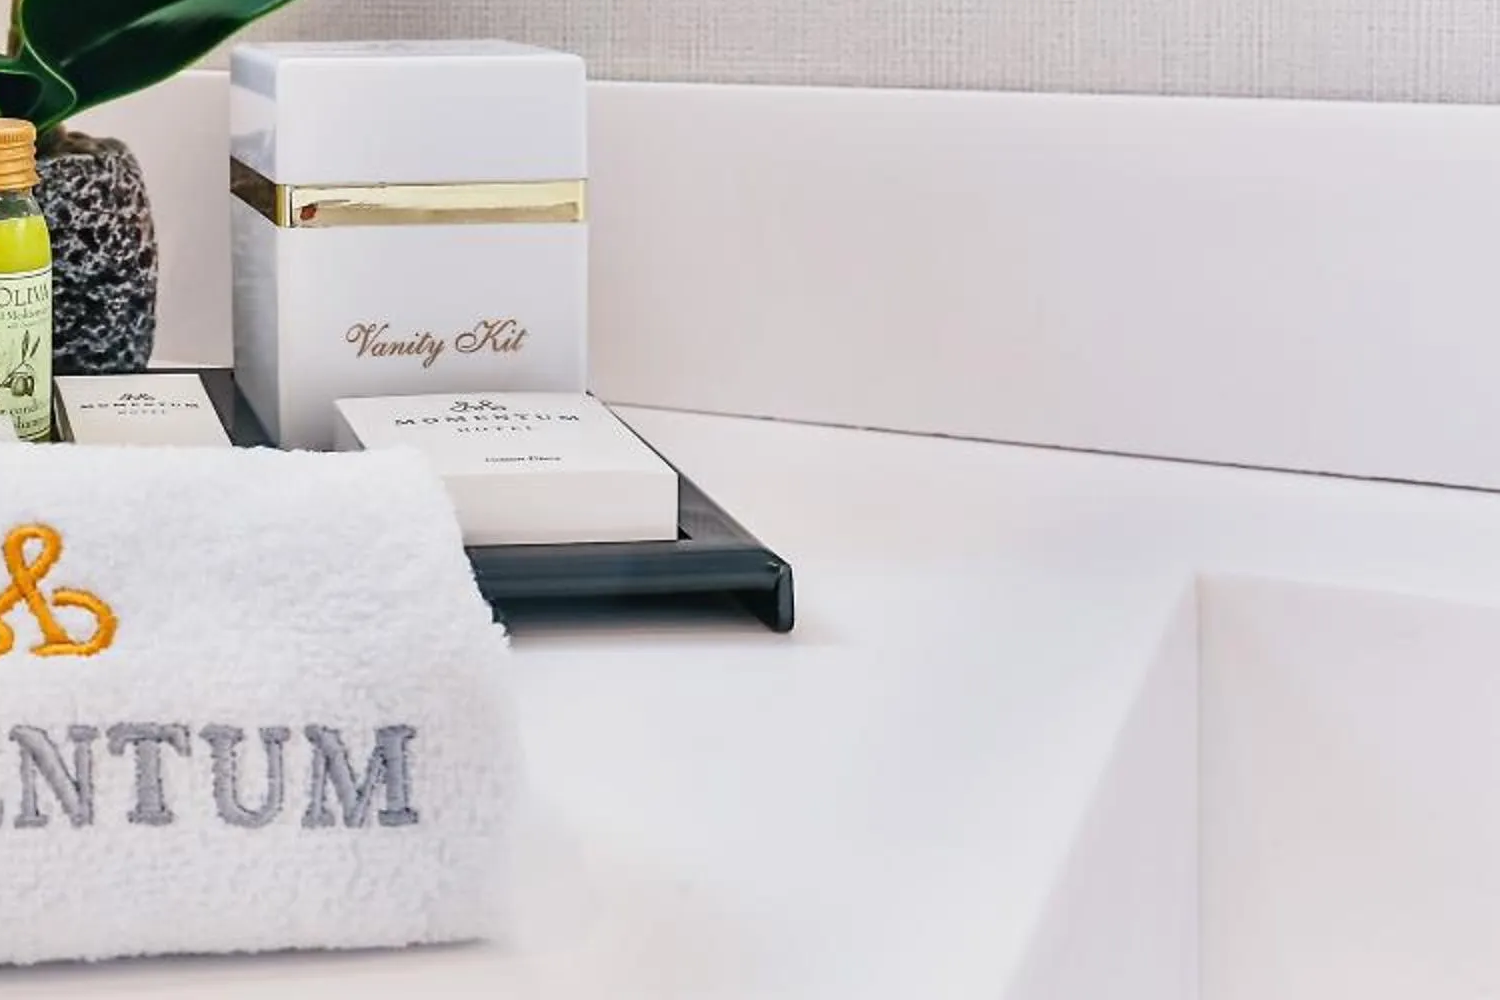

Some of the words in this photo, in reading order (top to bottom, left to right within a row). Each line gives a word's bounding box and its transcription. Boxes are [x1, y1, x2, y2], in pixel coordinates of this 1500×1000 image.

[345, 322, 445, 368] Vanity
[455, 319, 527, 353] Kit
[394, 413, 580, 425] MOMENTUM
